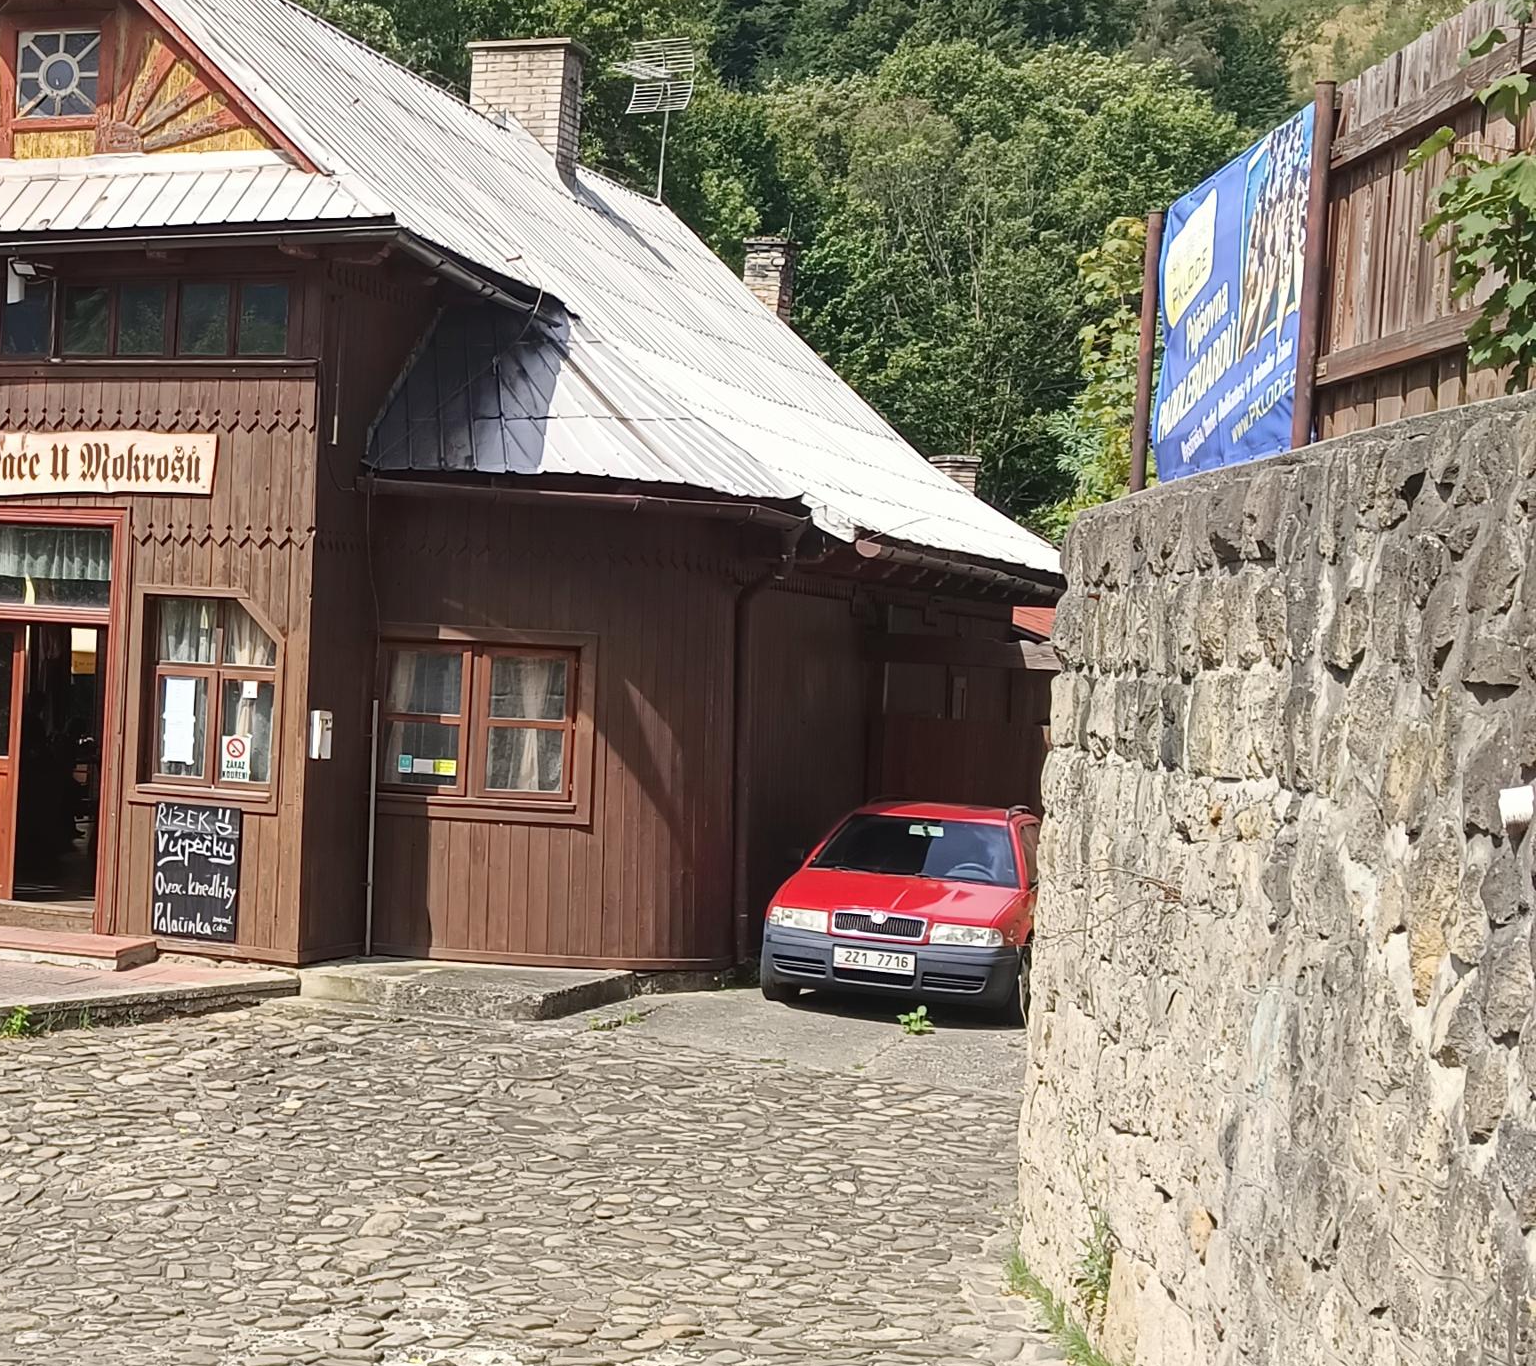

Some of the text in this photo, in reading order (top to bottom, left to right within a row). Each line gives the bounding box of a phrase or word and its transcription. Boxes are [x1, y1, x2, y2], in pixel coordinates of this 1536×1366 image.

[80, 442, 201, 485] Mokrošů
[844, 950, 909, 968] 2Z1 7716
